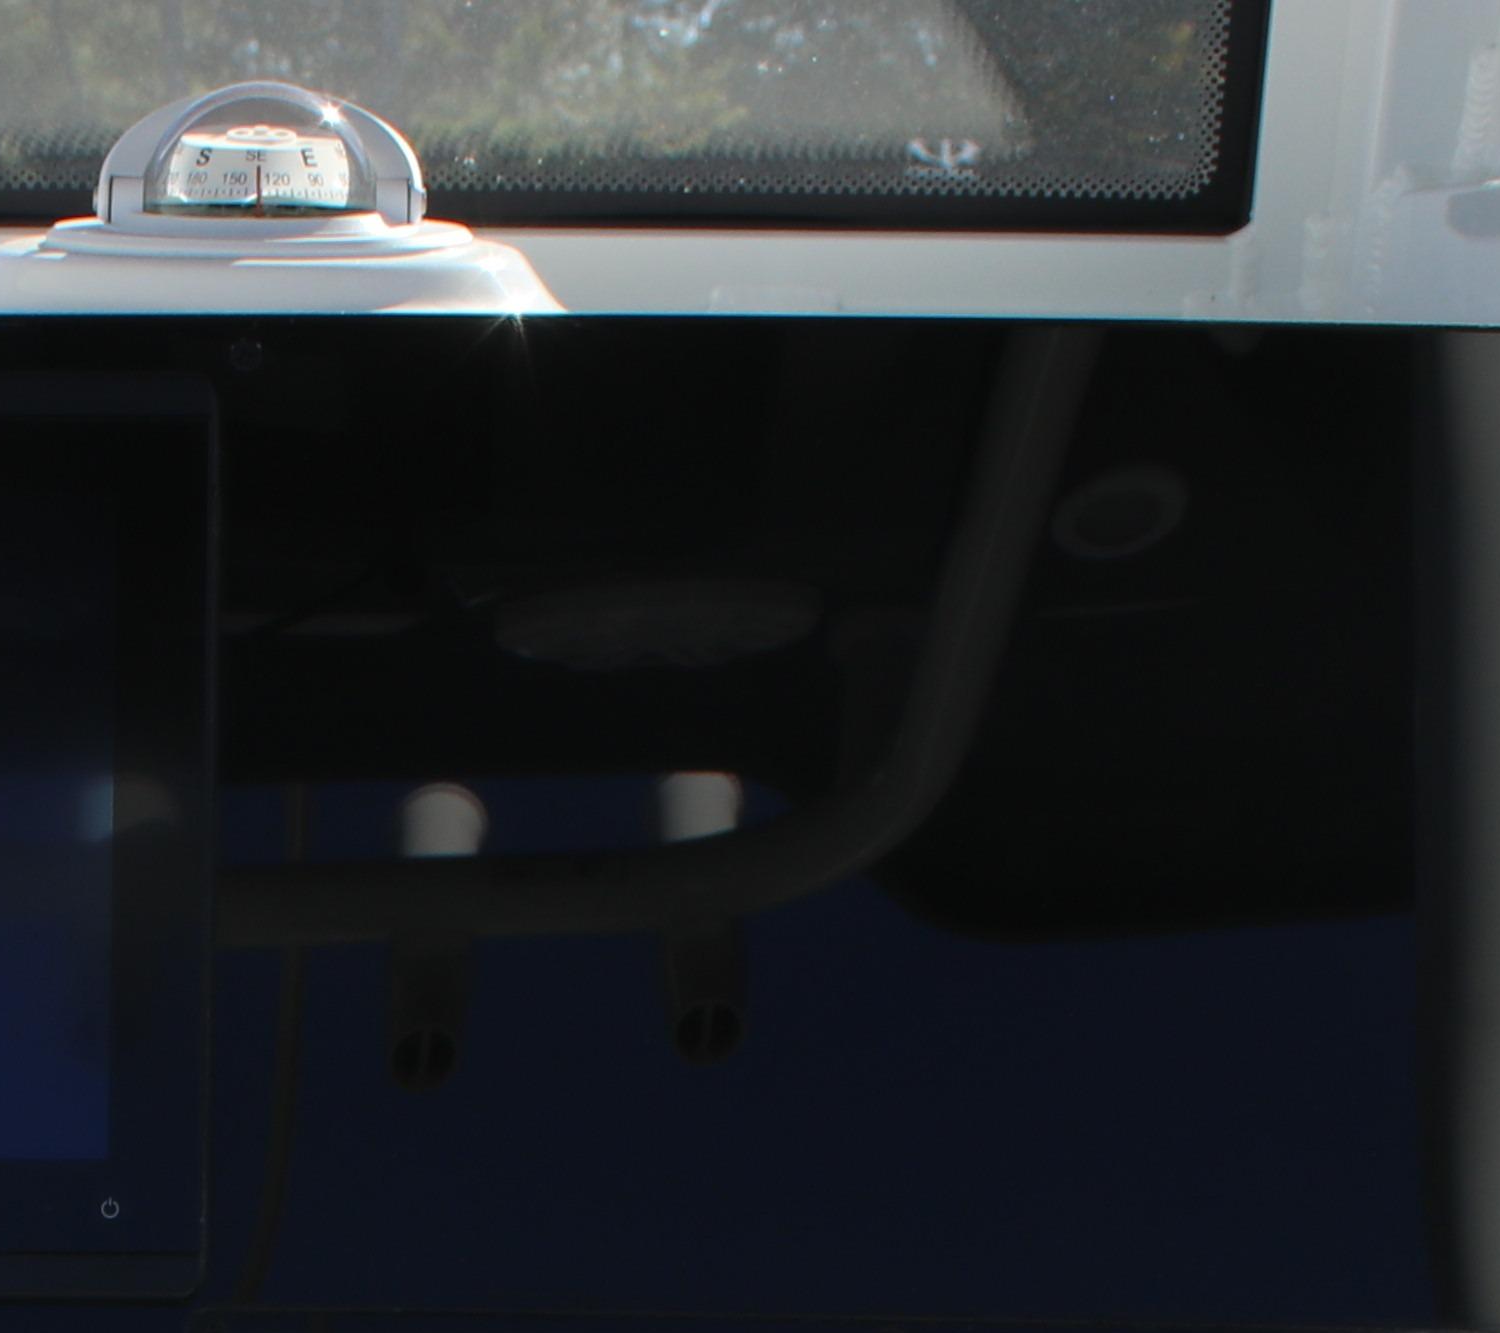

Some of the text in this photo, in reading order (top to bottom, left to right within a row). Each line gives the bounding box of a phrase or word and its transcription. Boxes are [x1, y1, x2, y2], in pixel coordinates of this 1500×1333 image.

[195, 147, 213, 167] S
[301, 147, 318, 168] E
[221, 172, 248, 185] 150
[265, 173, 291, 186] 120
